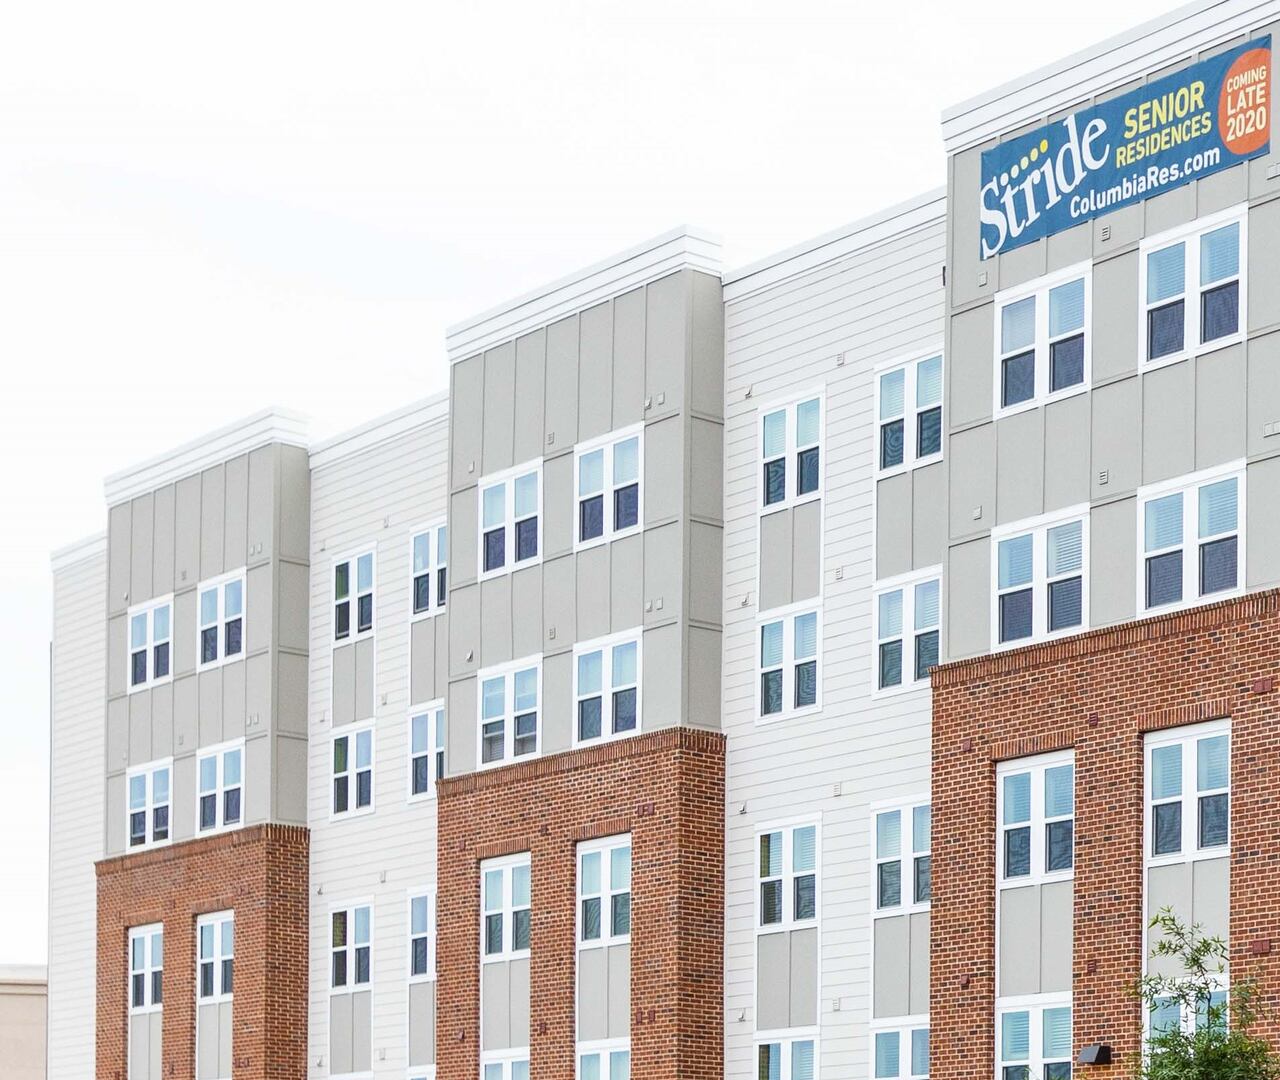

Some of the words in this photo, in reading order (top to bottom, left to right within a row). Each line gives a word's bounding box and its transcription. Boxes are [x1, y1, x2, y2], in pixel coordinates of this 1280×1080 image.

[1227, 65, 1267, 91] COMING
[1227, 82, 1267, 116] LATE
[1124, 81, 1205, 139] SENIOR
[1226, 106, 1267, 143] 2020
[1116, 111, 1212, 169] RESIDENCES
[980, 114, 1111, 260] Stride
[1070, 147, 1221, 218] ColumbiaRes.com
